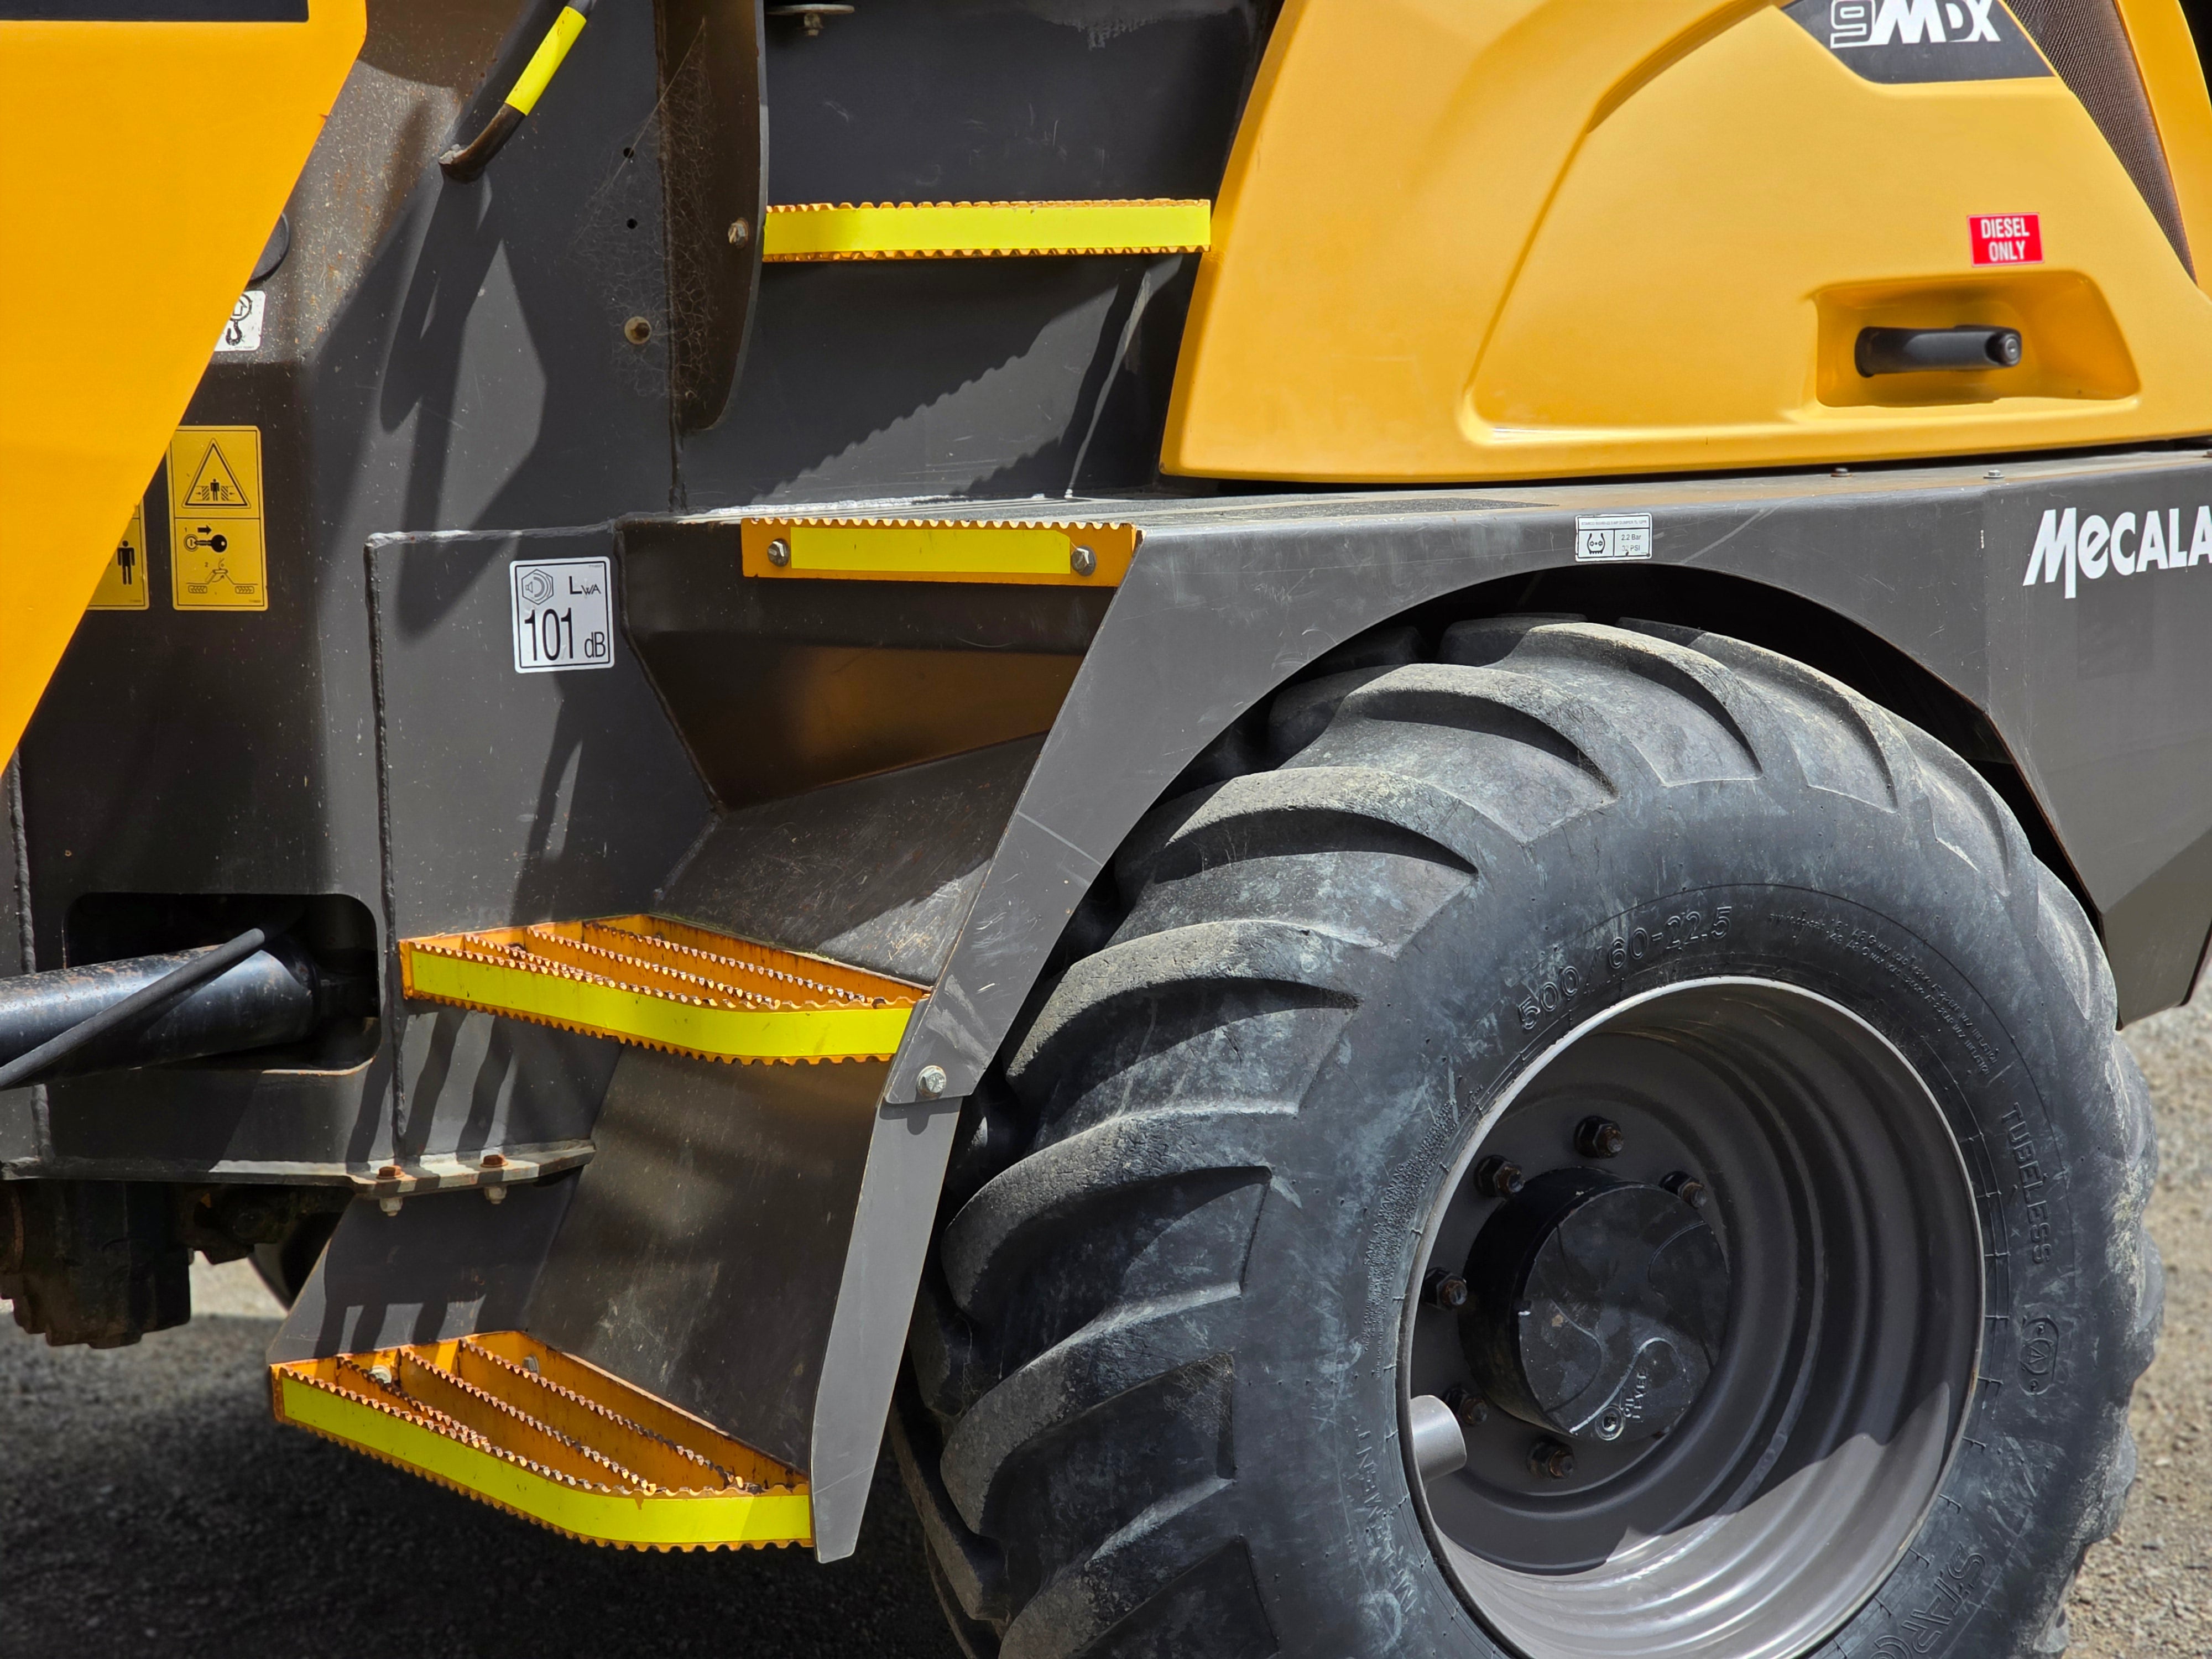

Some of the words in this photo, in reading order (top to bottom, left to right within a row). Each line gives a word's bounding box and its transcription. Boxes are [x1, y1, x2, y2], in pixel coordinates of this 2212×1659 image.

[1980, 217, 2030, 239] DIESEL
[1988, 240, 2025, 262] ONLY
[524, 607, 573, 661] 101
[584, 632, 606, 659] dB
[2001, 1102, 2052, 1264] TUBELESS
[1871, 1541, 1985, 1659] STARC
